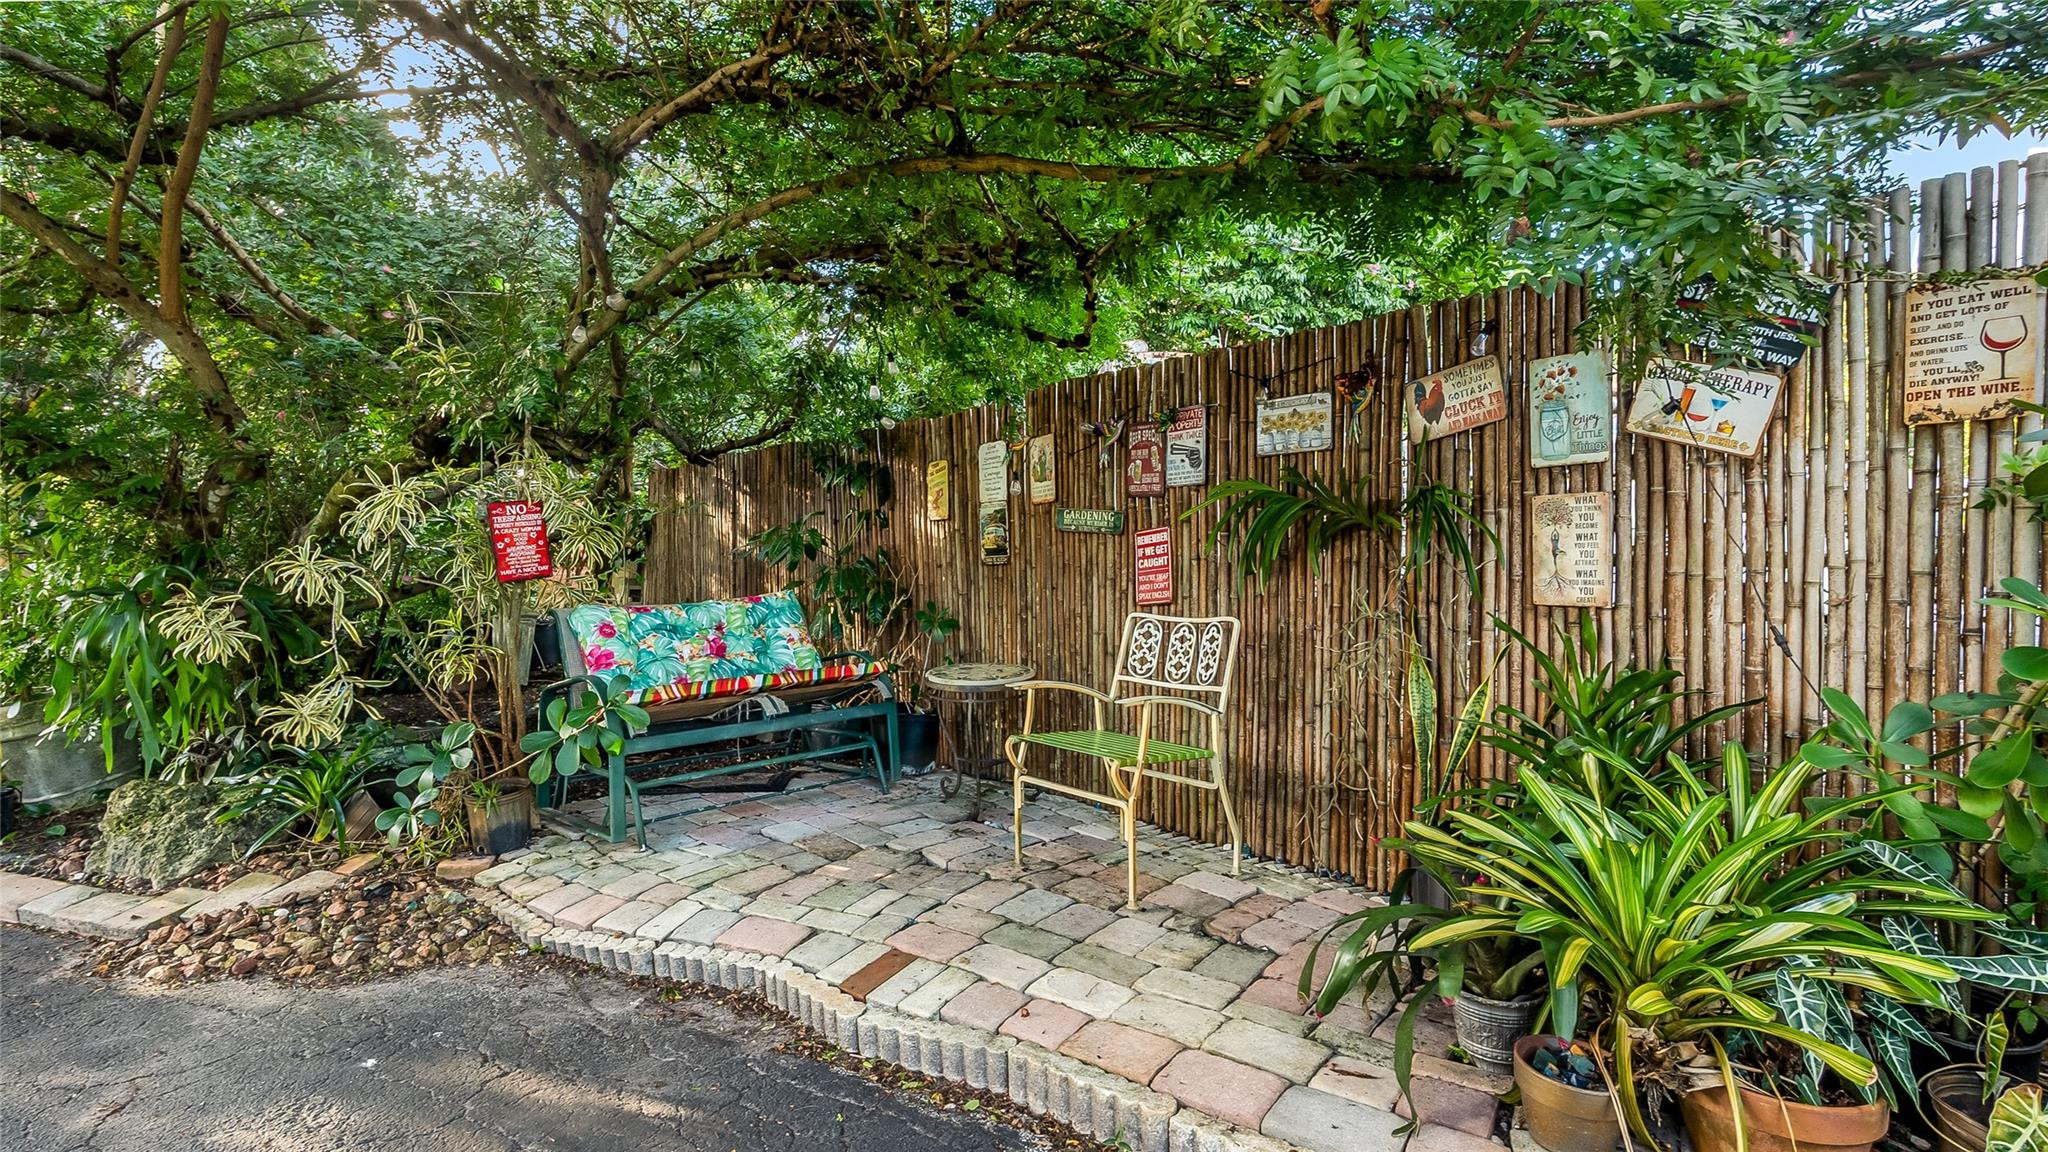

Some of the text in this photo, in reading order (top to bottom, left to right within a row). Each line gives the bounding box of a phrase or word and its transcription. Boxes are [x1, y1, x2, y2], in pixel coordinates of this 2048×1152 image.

[1910, 285, 2032, 312] IF YOU EAT WELL
[1910, 301, 2010, 323] AND GET LOTS OF
[1773, 330, 1804, 344] JESU
[1910, 344, 1968, 358] AND DRINK LOTS
[1766, 351, 1798, 366] WAY
[1443, 359, 1495, 384] SOMETIMES
[1452, 372, 1488, 389] YOU JUST
[1909, 374, 1980, 388] DIE ANYWAY!
[1448, 380, 1494, 402] GOTTA SAY
[1906, 389, 1941, 402] OPEN
[1947, 386, 1976, 398] THE
[1444, 390, 1503, 419] CLUCK IT
[1573, 412, 1604, 430] Enjoy
[1168, 430, 1203, 442] THINK TWICE
[1577, 429, 1604, 439] LITTLE
[1571, 440, 1609, 454] Things
[1574, 496, 1598, 504] WHAT
[505, 504, 526, 515] NO
[1063, 509, 1115, 521] GARDENING
[492, 513, 542, 523] TRESPASSING
[1578, 513, 1595, 521] YOU
[1137, 532, 1168, 545] REMEMBER
[1576, 533, 1599, 541] WHAT
[1137, 544, 1168, 557] IF WE GET
[1579, 550, 1595, 558] YOU
[1139, 556, 1168, 568] CAUGHT
[1576, 570, 1598, 578] WHAT
[1579, 587, 1594, 595] YOU
